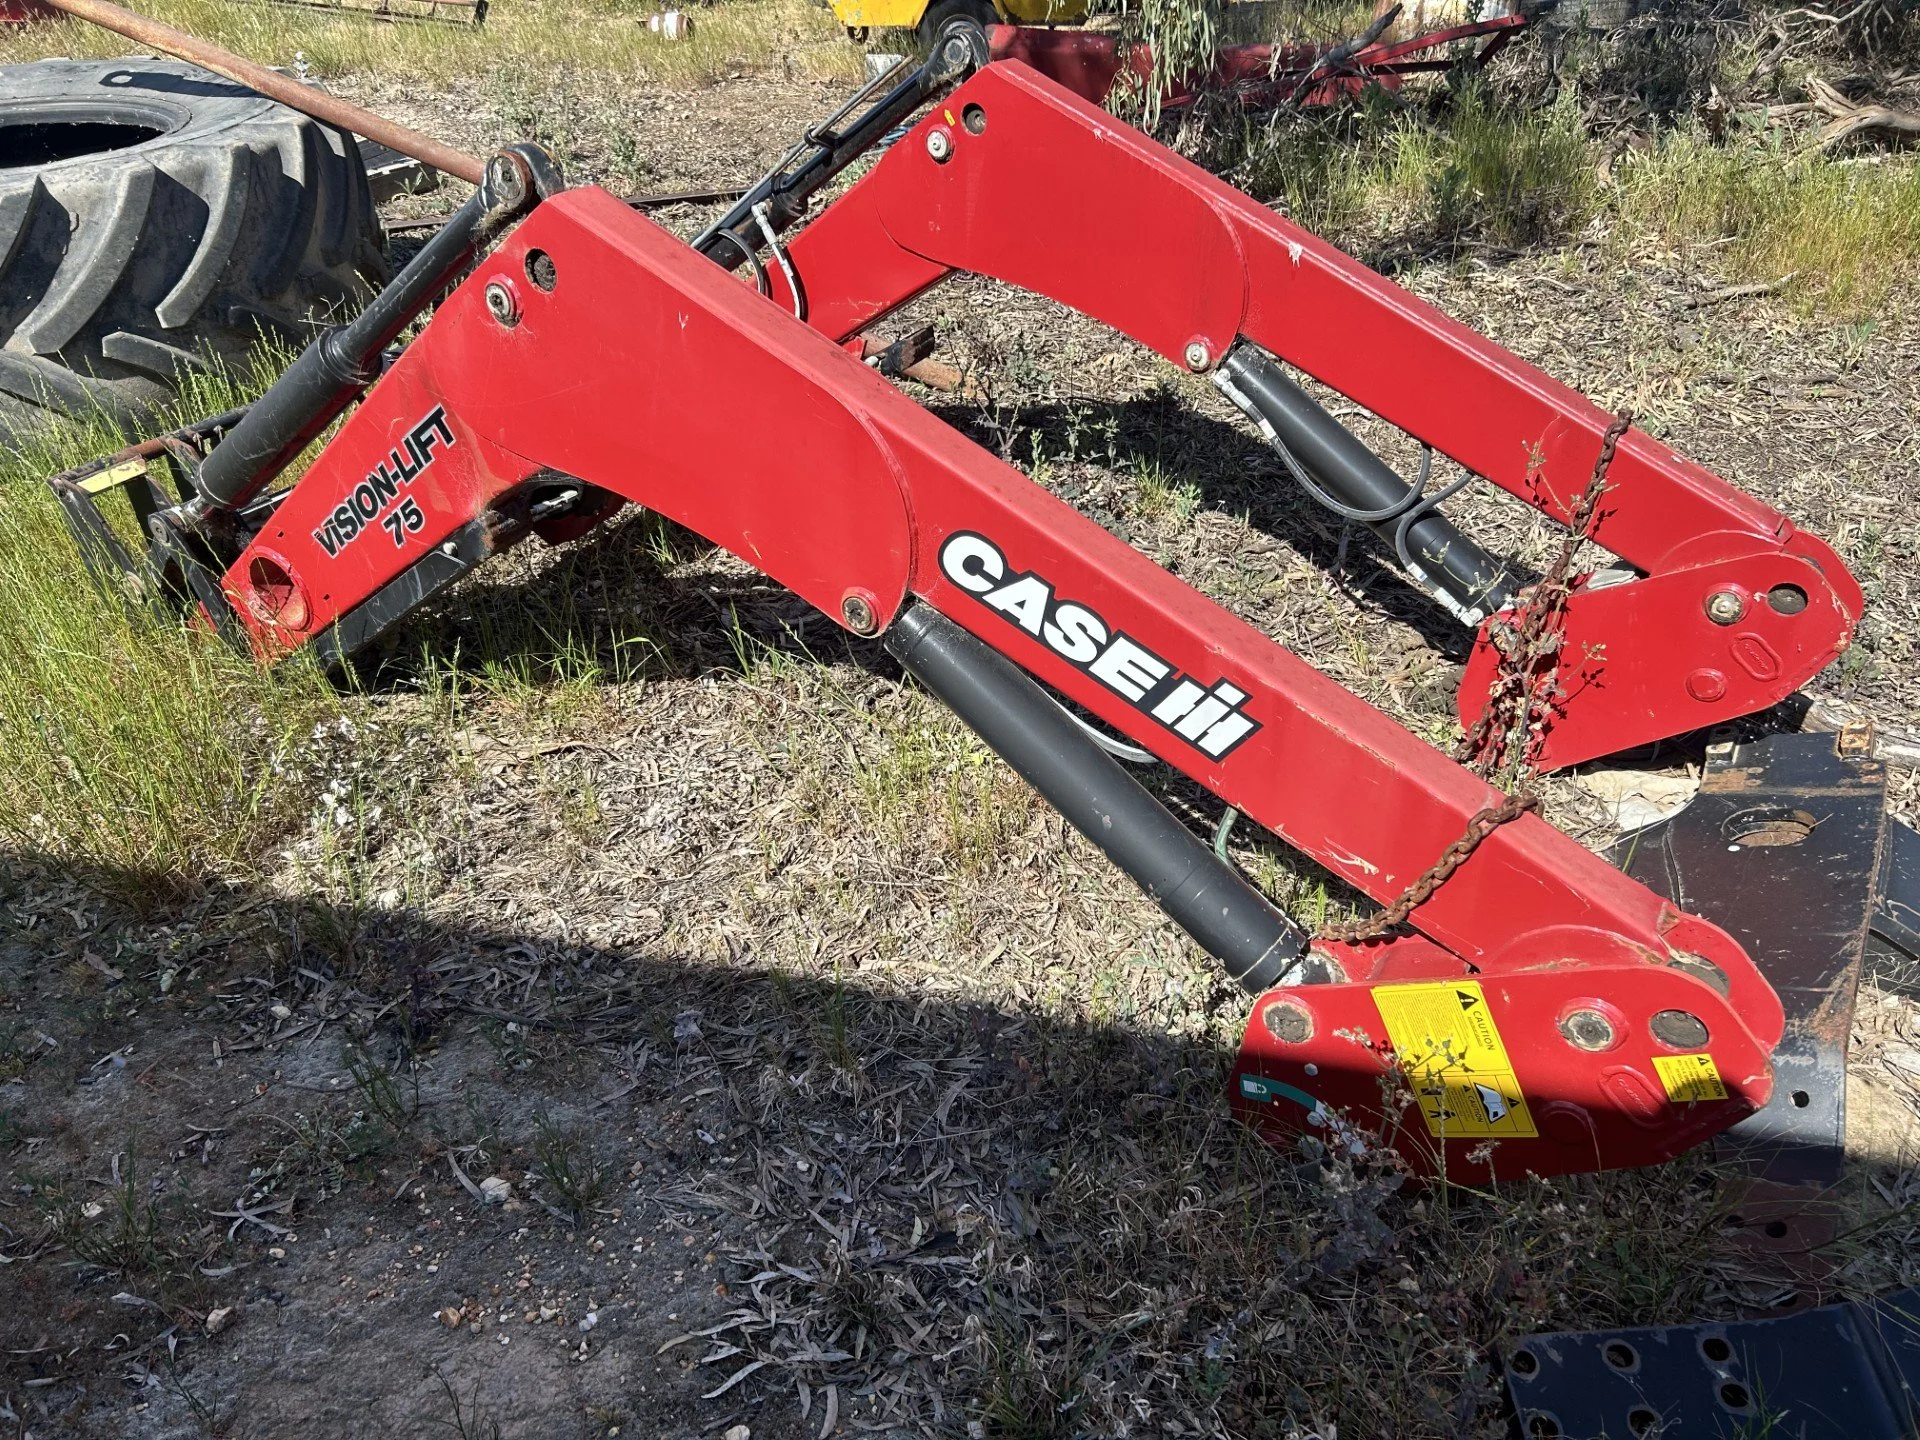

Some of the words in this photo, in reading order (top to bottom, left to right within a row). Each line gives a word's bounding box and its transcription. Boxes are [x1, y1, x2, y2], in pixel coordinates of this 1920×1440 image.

[312, 404, 456, 558] VISION-LIFT
[382, 496, 424, 547] 75
[940, 532, 1173, 704] CASE
[1472, 1010, 1496, 1052] CAUTION
[1704, 1067, 1725, 1097] CAUTION
[1467, 1095, 1485, 1124] CAUTION
